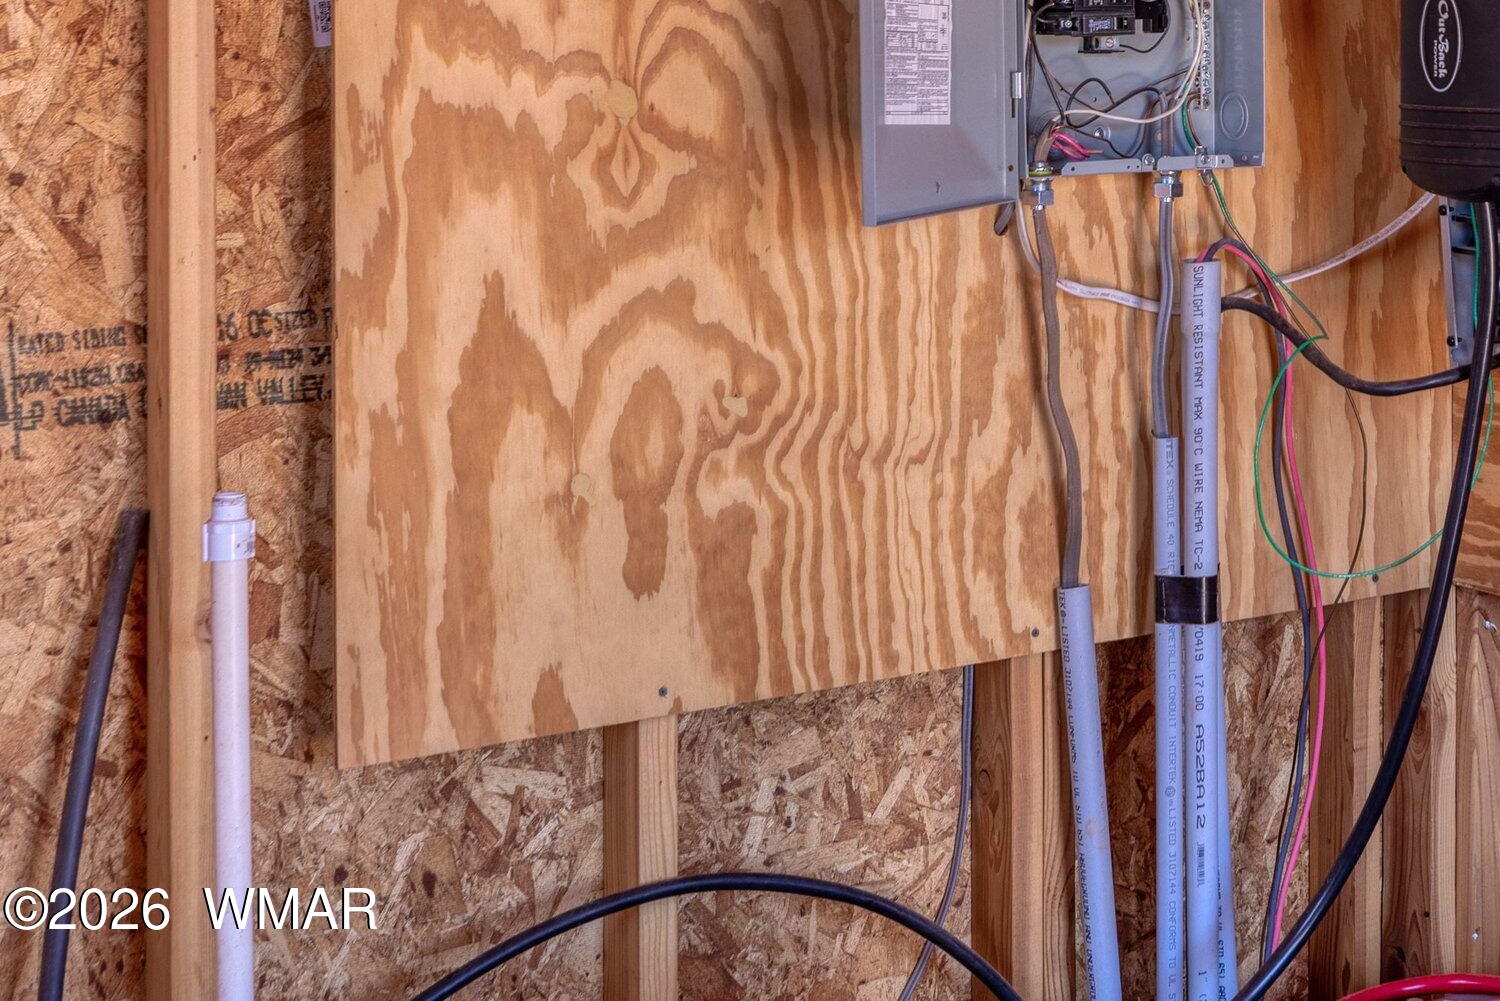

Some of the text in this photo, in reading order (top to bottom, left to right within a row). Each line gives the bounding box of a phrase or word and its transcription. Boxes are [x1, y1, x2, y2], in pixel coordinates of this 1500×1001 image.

[1193, 265, 1204, 318] SUNLIGHT
[1193, 324, 1204, 389] RESISTANT
[1193, 397, 1204, 420] MAX
[1193, 463, 1204, 494] WIRE
[1193, 501, 1204, 533] NEMA
[1168, 686, 1177, 728] CONDUIT
[1194, 674, 1205, 711] 17:00
[1168, 736, 1177, 784] INTERTEK
[1168, 808, 1177, 846] LISTED
